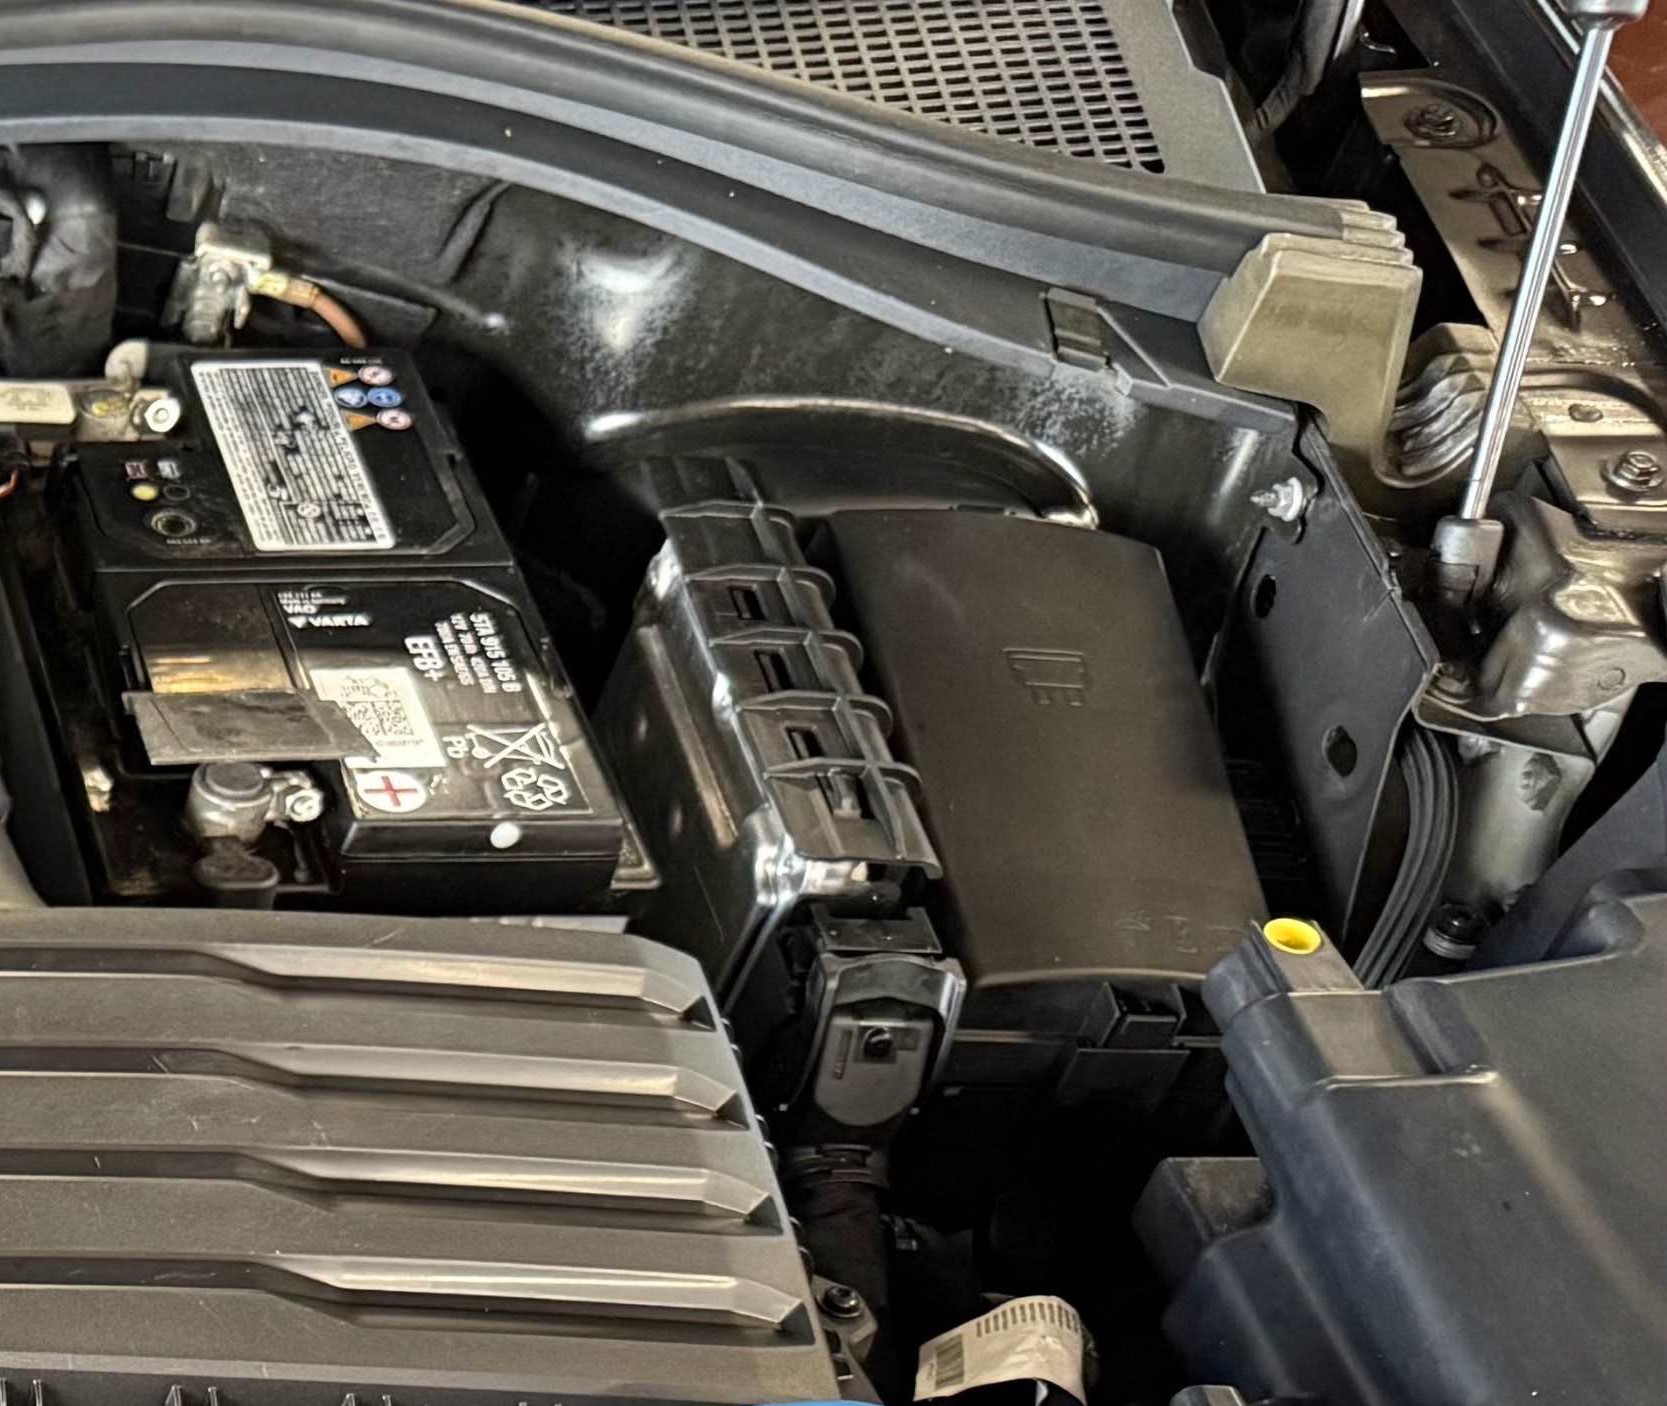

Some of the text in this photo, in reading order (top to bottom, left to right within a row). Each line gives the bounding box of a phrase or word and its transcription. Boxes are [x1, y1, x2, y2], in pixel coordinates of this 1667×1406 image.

[308, 614, 370, 628] VARTA
[470, 612, 495, 637] 5TA
[404, 636, 446, 682] EFB+
[480, 635, 507, 660] 915
[492, 659, 517, 683] 105
[441, 735, 469, 759] Pb
